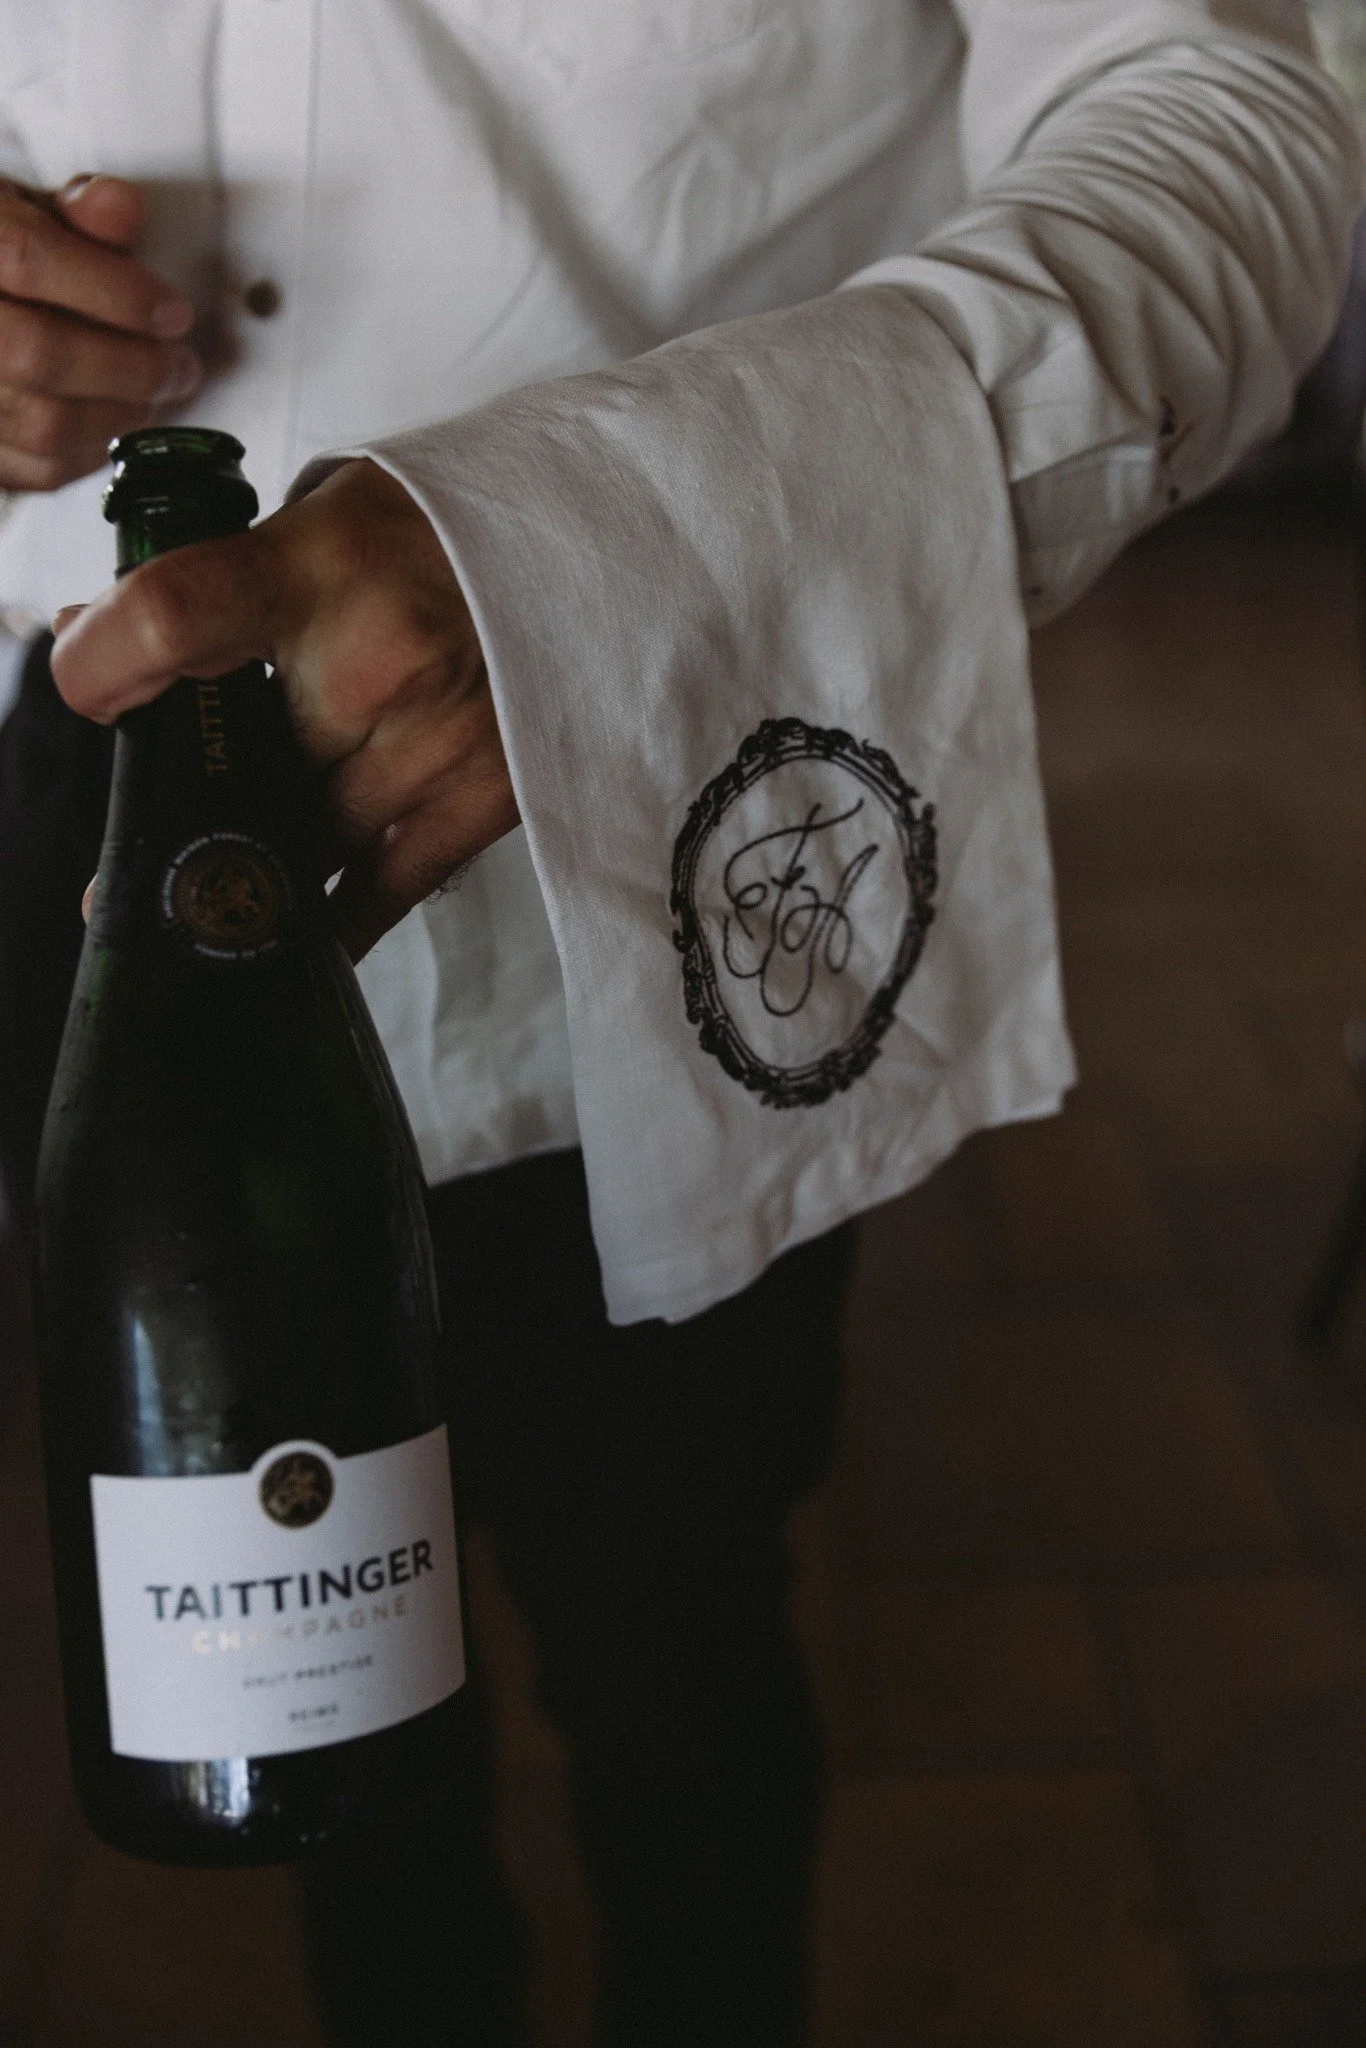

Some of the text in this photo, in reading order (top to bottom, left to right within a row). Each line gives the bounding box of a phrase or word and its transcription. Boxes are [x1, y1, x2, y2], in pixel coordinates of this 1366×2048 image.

[197, 684, 230, 777] TAITTI
[145, 1539, 434, 1620] TAITTINGER
[192, 1594, 406, 1653] CHMPAGNE
